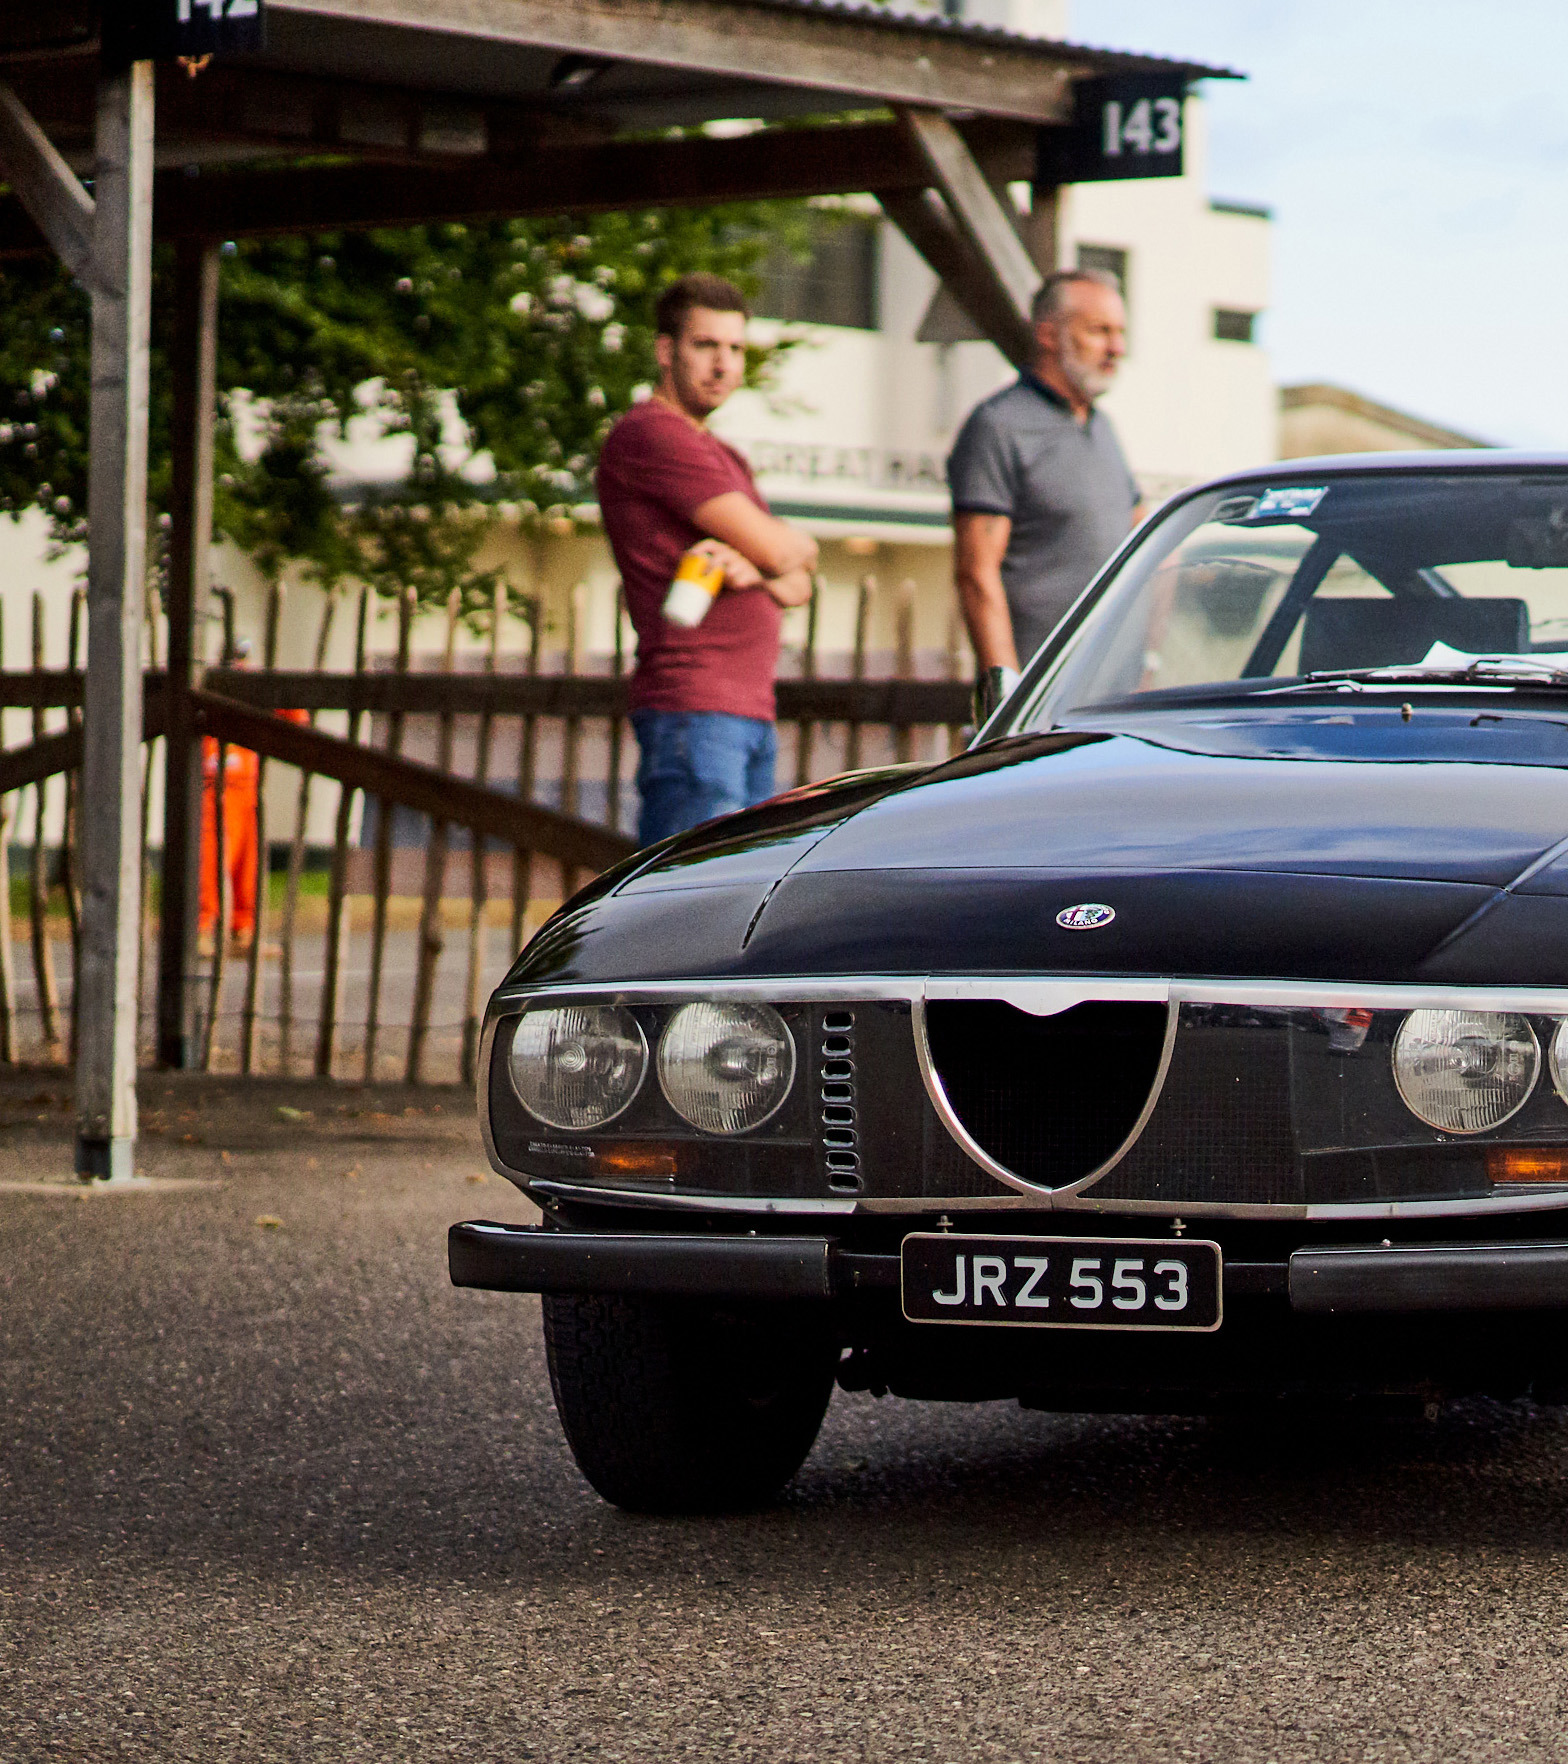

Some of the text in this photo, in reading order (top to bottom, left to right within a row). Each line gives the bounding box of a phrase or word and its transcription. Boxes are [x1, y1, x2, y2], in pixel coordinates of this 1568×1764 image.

[1104, 98, 1180, 155] 143
[884, 450, 949, 484] HA
[1063, 917, 1099, 926] MILANO
[932, 1255, 1190, 1310] JRZ 553
